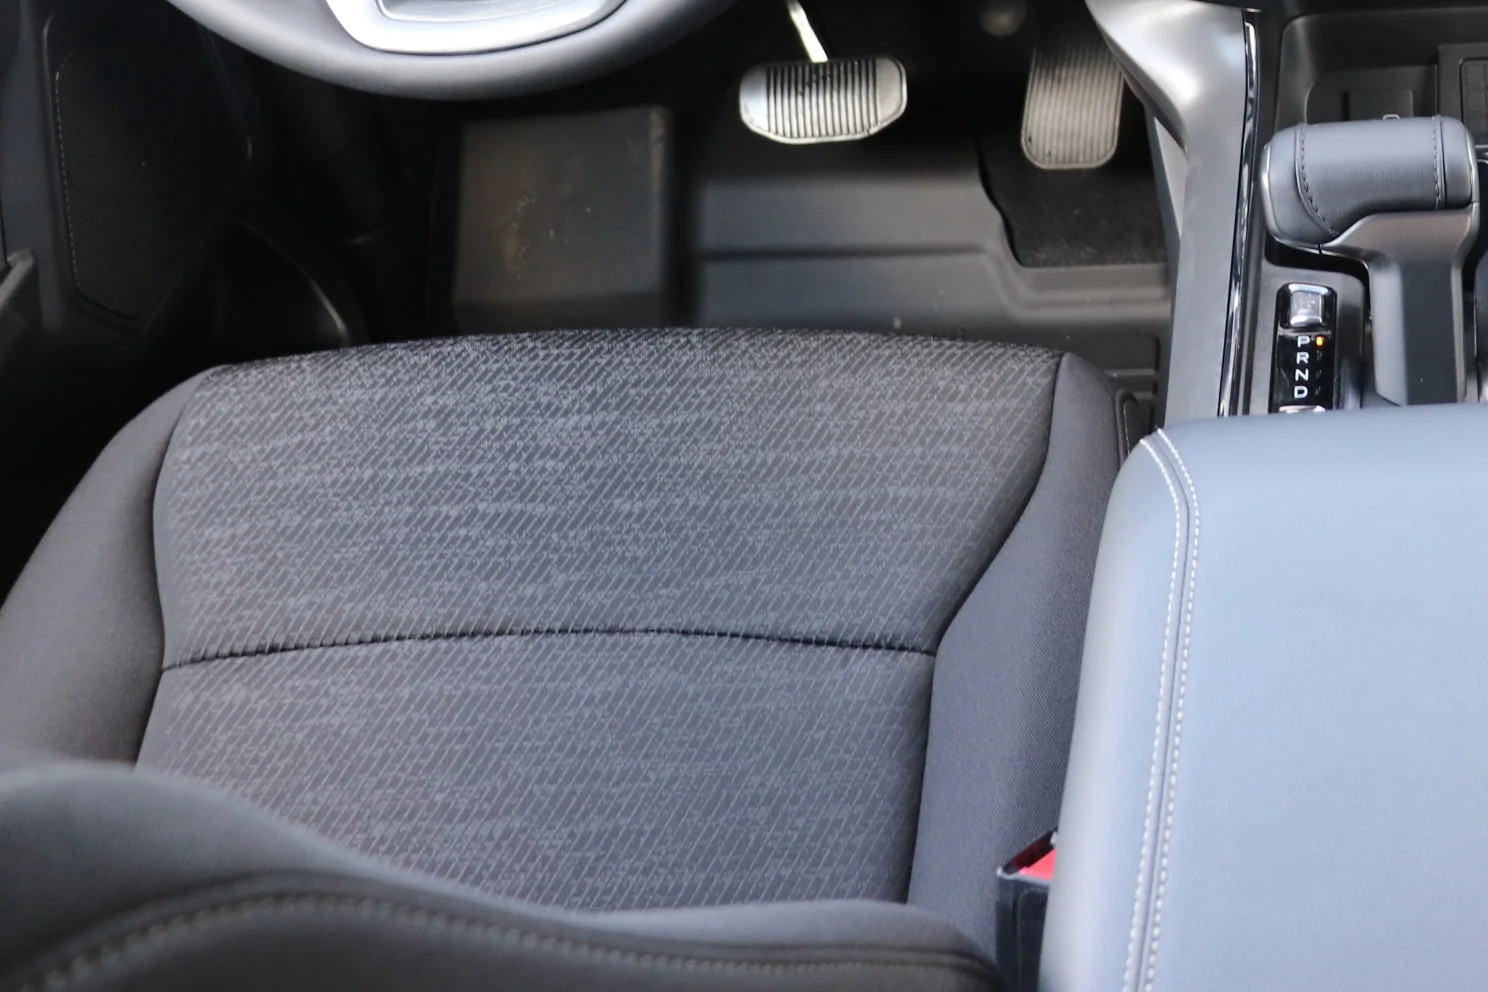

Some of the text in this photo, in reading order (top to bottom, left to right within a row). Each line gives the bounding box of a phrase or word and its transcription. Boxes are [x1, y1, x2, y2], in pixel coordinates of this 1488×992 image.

[1297, 335, 1311, 348] P
[1296, 351, 1310, 365] R
[1294, 368, 1309, 382] N
[1293, 385, 1309, 399] D
